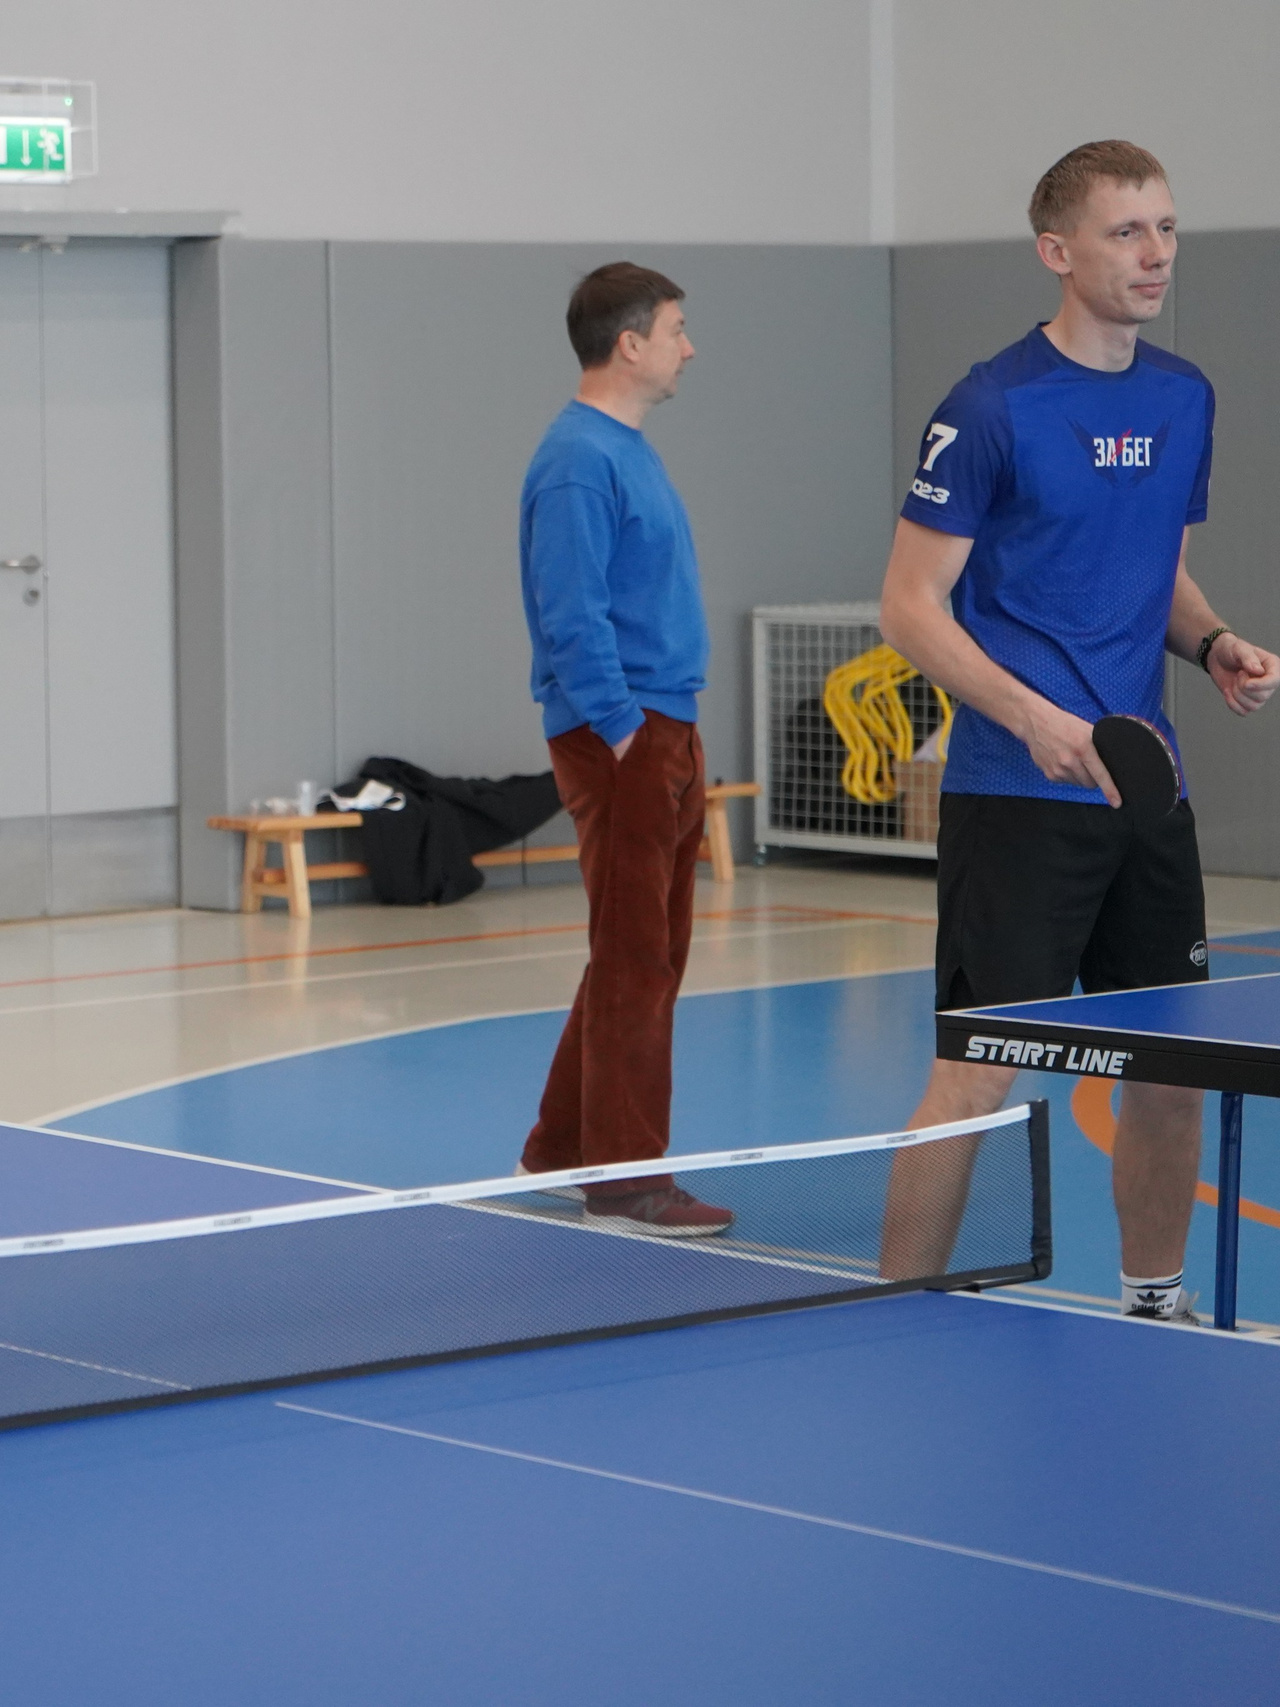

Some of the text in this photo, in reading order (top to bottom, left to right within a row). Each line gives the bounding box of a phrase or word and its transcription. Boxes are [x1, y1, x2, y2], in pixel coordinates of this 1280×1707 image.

[922, 422, 959, 472] 7
[910, 478, 951, 504] 023
[965, 1035, 1064, 1067] START
